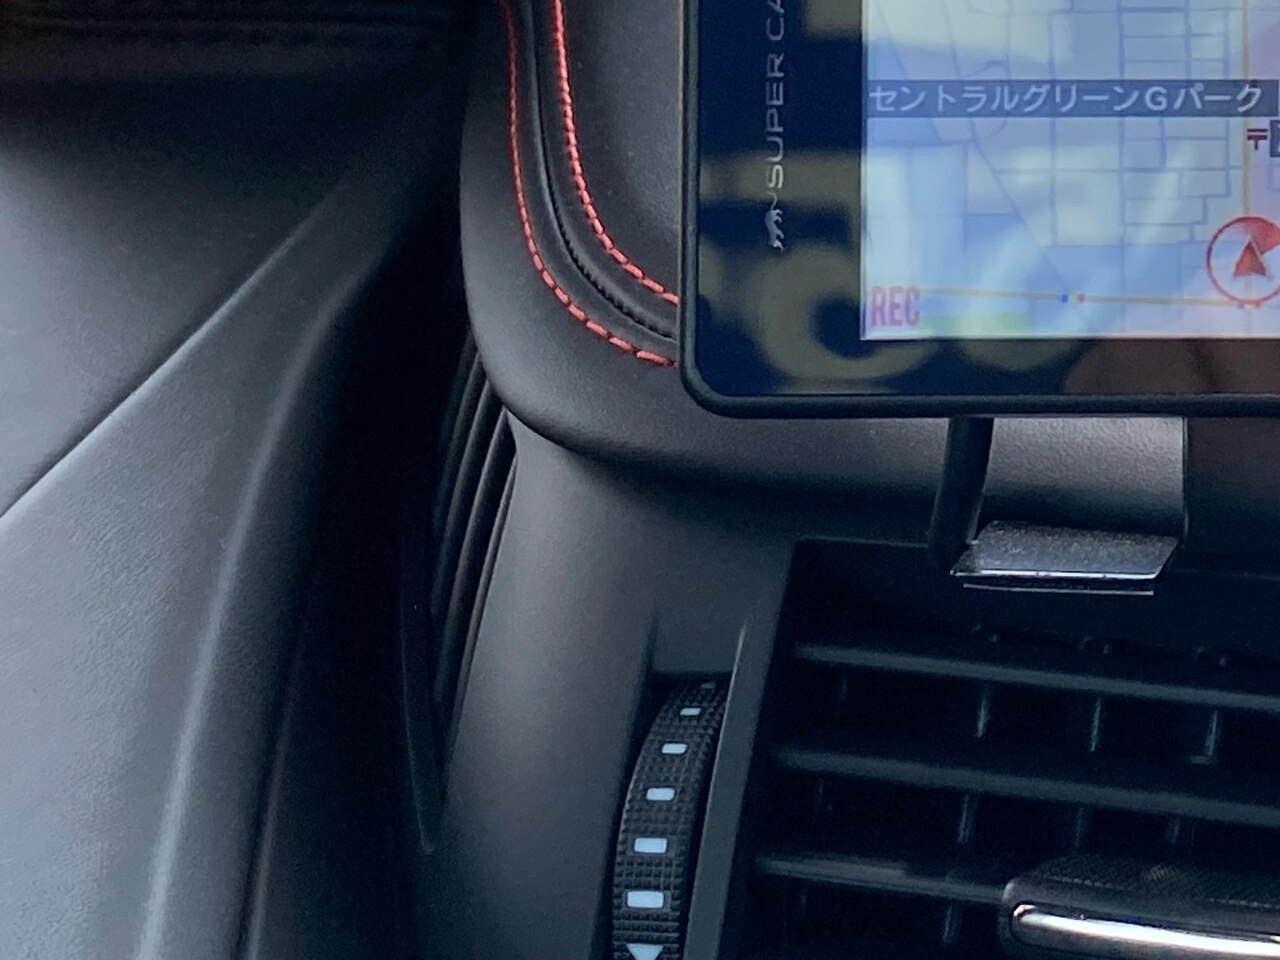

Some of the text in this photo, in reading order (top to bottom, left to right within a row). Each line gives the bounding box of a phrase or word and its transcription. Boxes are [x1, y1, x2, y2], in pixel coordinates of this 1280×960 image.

[868, 82, 1264, 114] セントラルグリーンGパーク
[765, 52, 785, 190] SUPER
[869, 286, 922, 328] REC
